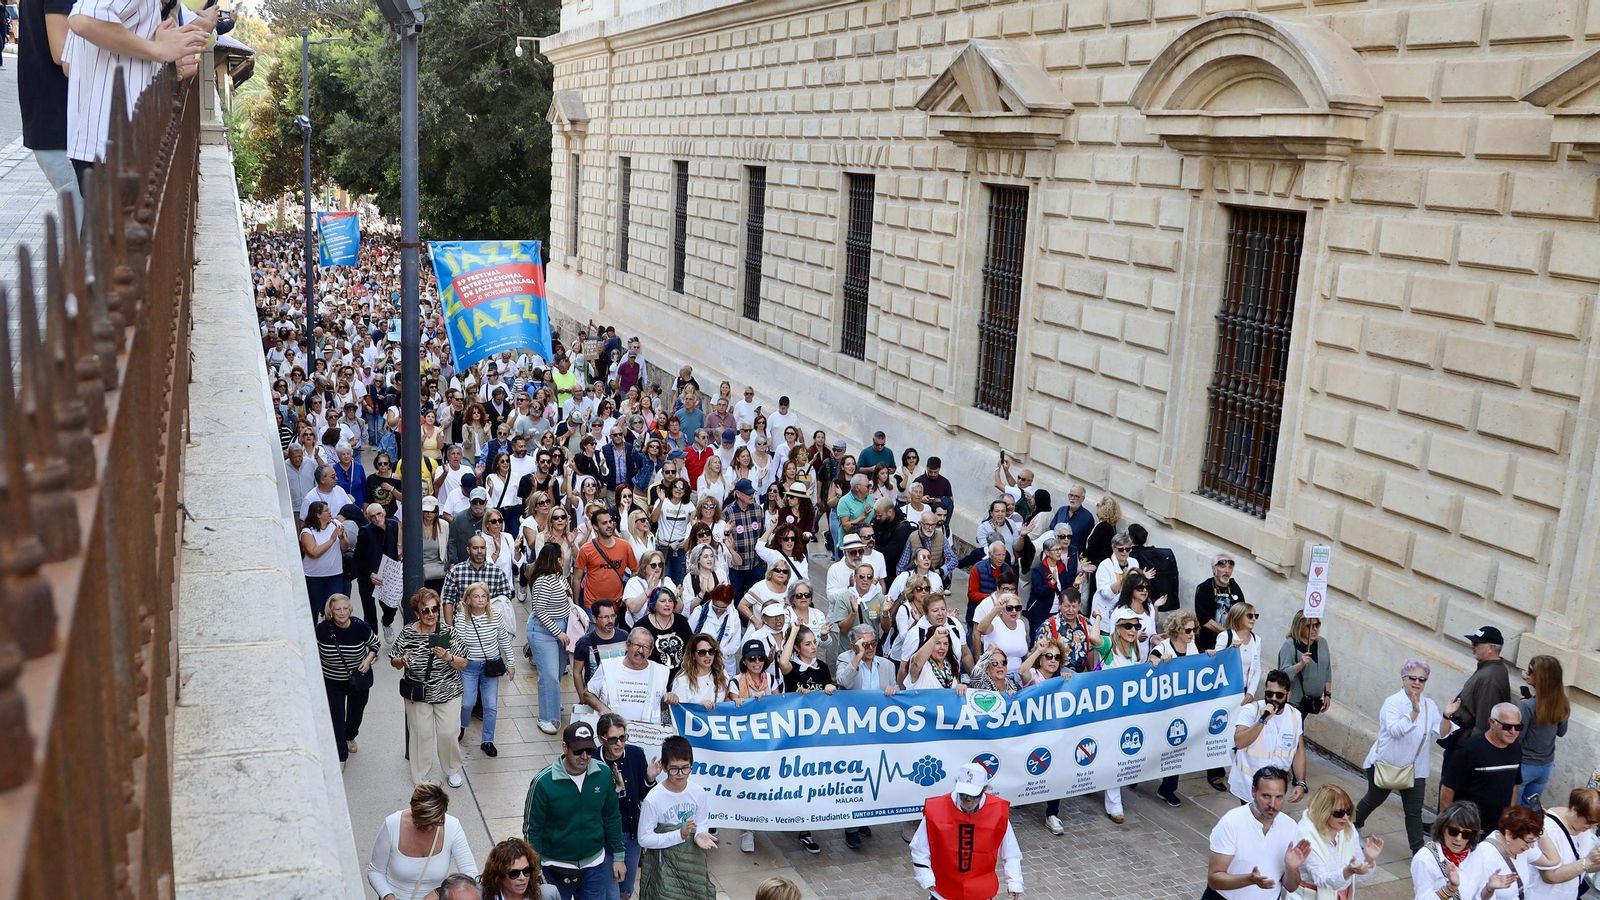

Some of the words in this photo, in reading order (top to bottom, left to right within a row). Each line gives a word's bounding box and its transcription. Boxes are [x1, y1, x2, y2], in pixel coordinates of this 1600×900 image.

[444, 241, 531, 277] JAZZ
[460, 272, 523, 293] INTERNACIONAL
[467, 270, 501, 282] FESTIVAL
[463, 290, 474, 299] DE
[475, 285, 494, 295] JAZZ
[456, 294, 539, 348] JAZZ
[684, 705, 926, 740] DEFENDAMOS
[936, 705, 979, 730] LA
[986, 684, 1115, 729] SANIDAD
[1122, 663, 1230, 707] PÚBLICA
[1127, 757, 1146, 765] Personal
[1206, 750, 1227, 758] Universal
[779, 755, 864, 778] blanca
[1117, 769, 1141, 777] Condiciones
[715, 784, 732, 798] la
[737, 785, 803, 801] sanidad
[807, 781, 863, 802] pública
[896, 806, 920, 814] SANIDAD
[735, 813, 769, 823] Usuari@s
[775, 816, 805, 824] Vecin@s
[810, 812, 850, 823] Estudiantes
